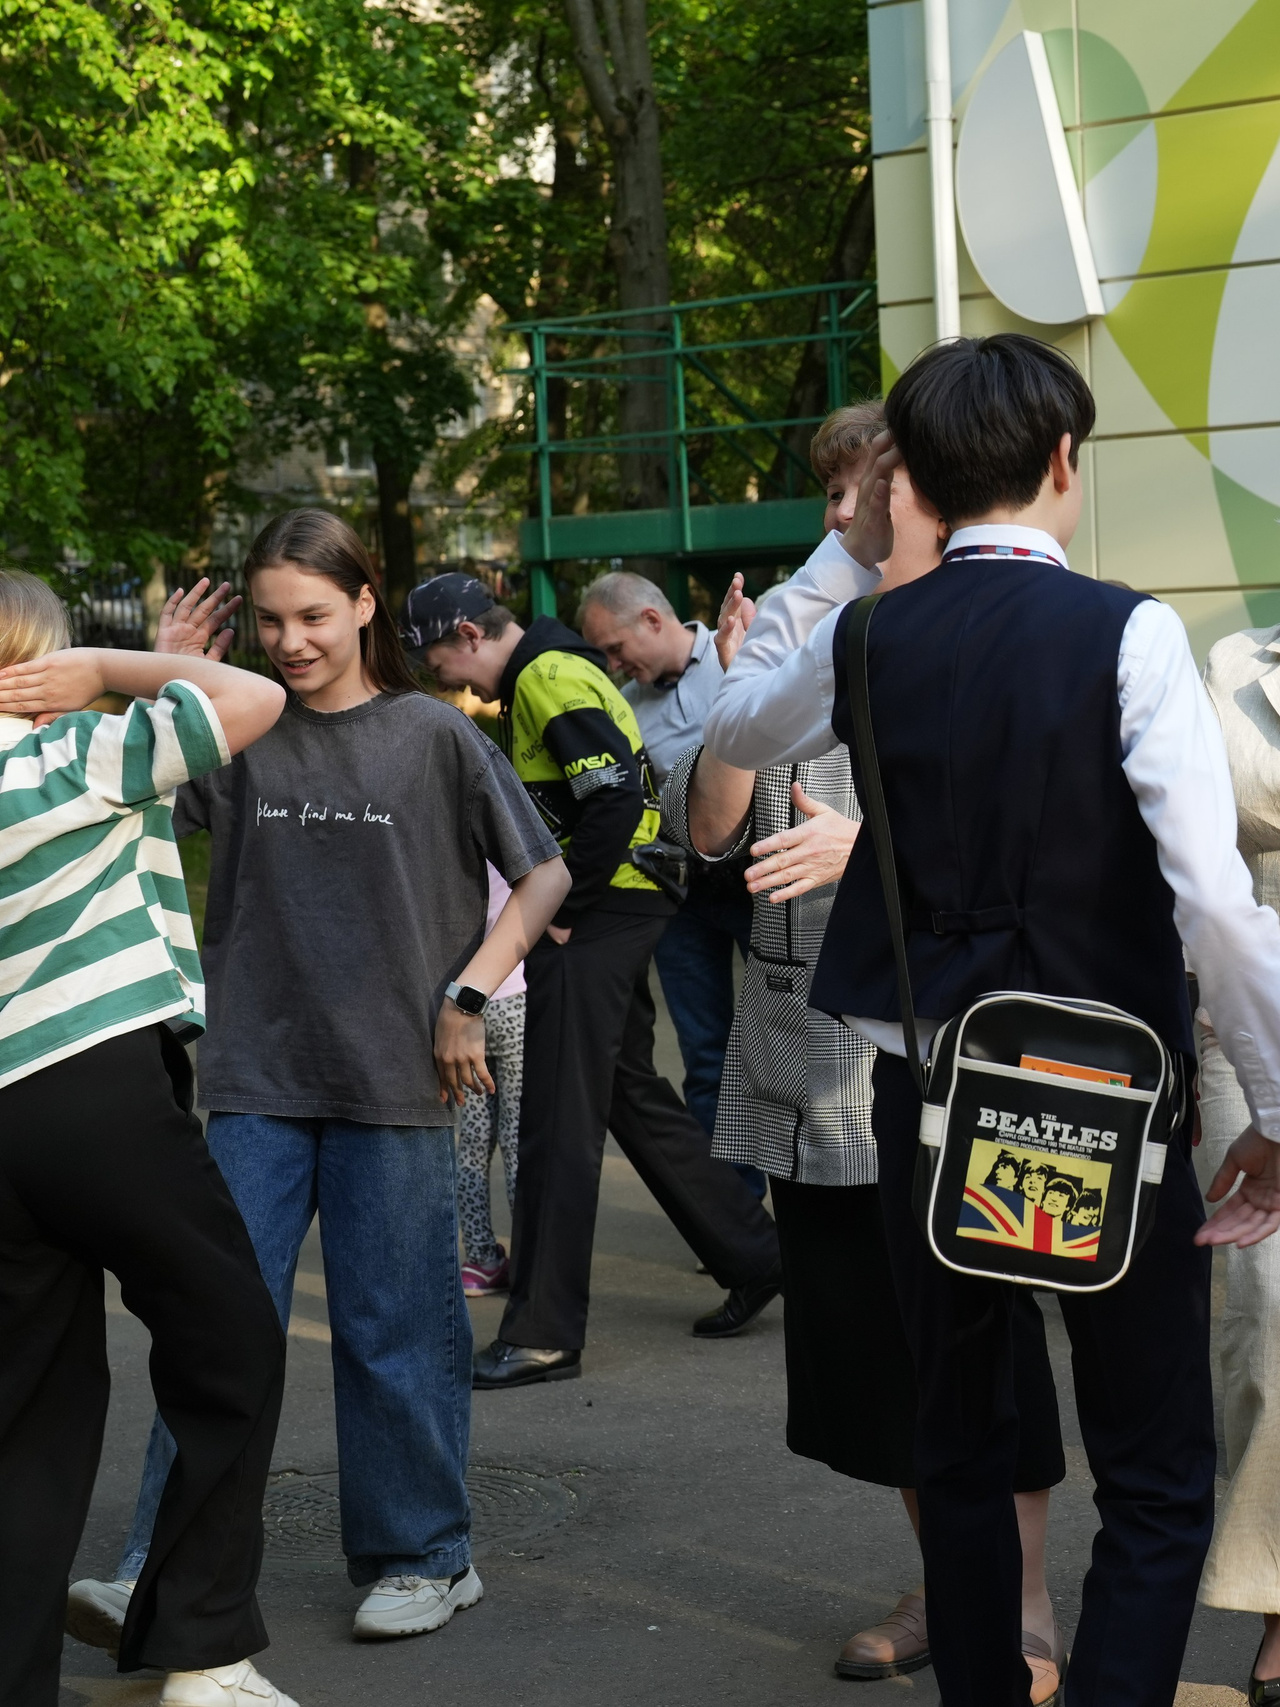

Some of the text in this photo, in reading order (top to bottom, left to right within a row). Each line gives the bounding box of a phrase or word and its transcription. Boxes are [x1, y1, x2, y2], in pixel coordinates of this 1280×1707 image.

[564, 752, 616, 779] NASA
[256, 797, 394, 826] please find me here
[977, 1107, 1119, 1151] BEATLES
[1040, 1112, 1058, 1122] THE
[1058, 1142, 1067, 1150] THE
[1067, 1143, 1085, 1153] BEATLES
